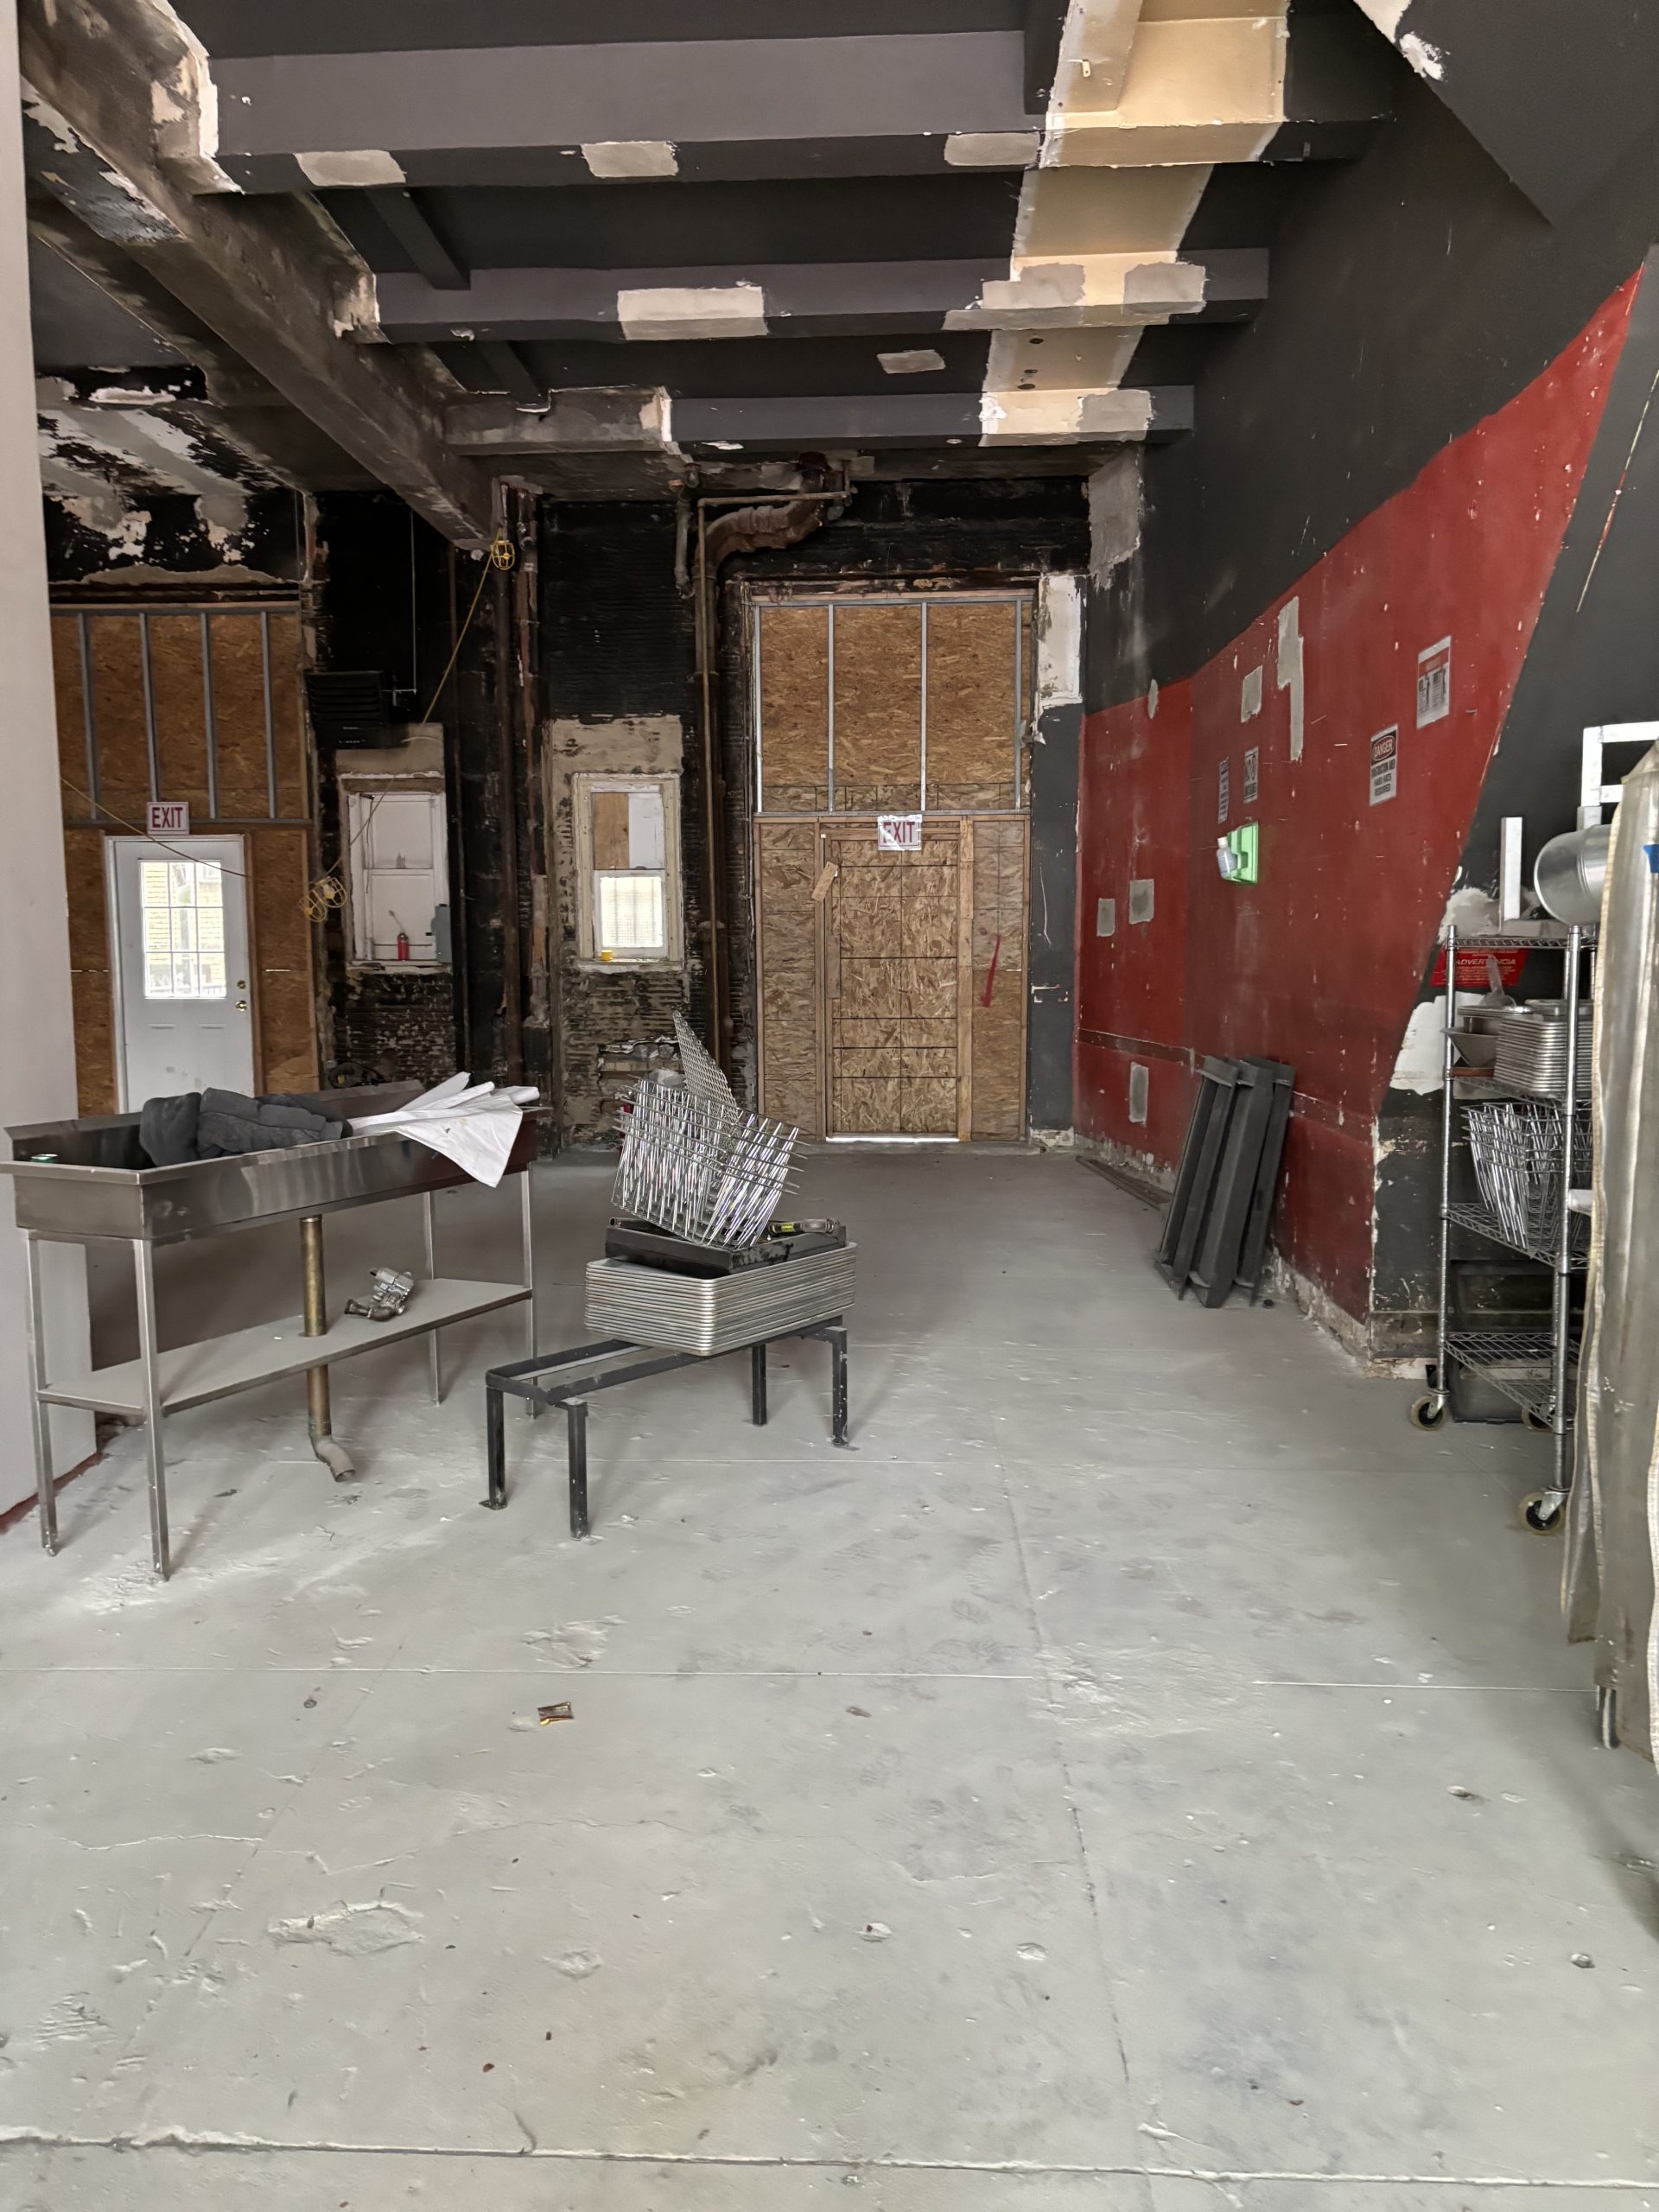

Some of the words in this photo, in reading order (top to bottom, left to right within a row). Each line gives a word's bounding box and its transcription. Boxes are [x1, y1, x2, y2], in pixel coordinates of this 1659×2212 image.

[1373, 739, 1393, 758] DANGER
[152, 807, 183, 828] EXIT
[883, 822, 915, 843] EXIT
